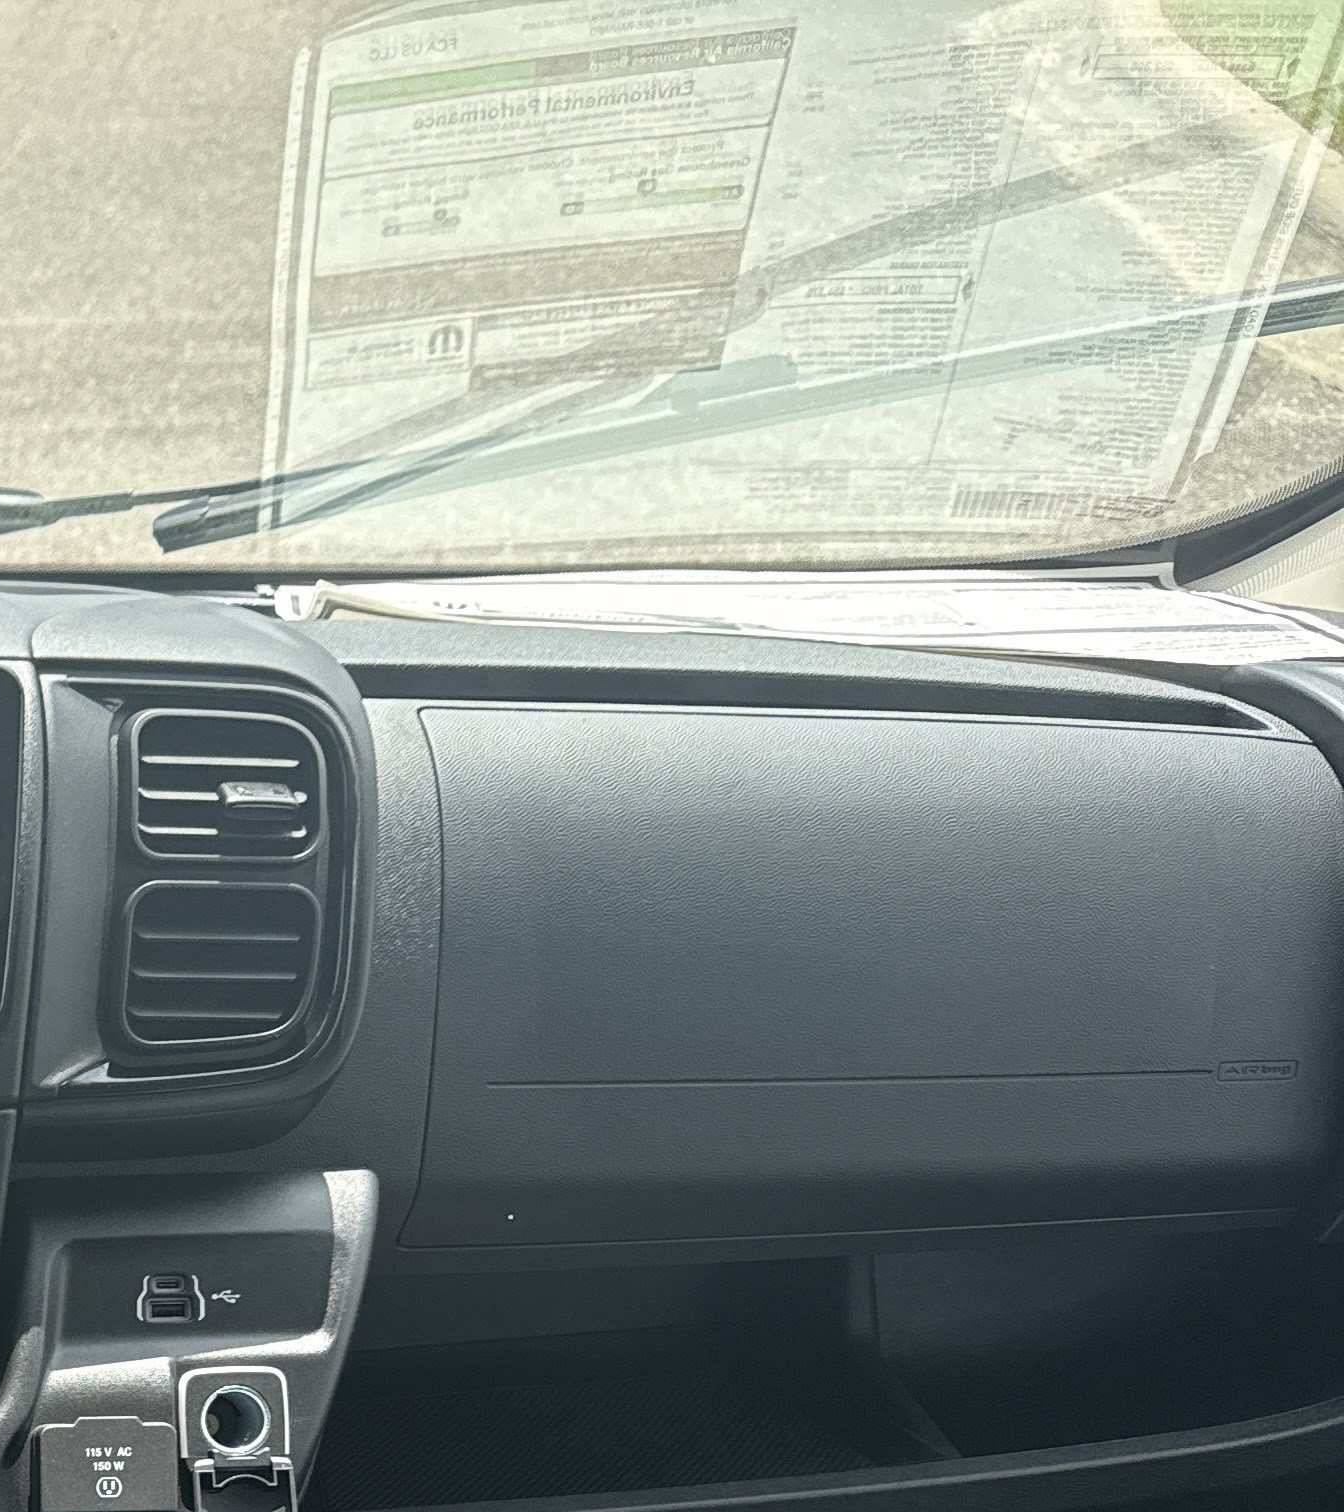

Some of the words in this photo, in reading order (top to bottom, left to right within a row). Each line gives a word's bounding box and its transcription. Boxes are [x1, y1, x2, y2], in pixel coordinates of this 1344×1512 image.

[84, 1447, 102, 1458] 115
[104, 1447, 113, 1458] V
[117, 1446, 133, 1457] AC
[92, 1461, 111, 1472] 150
[113, 1461, 125, 1471] W
